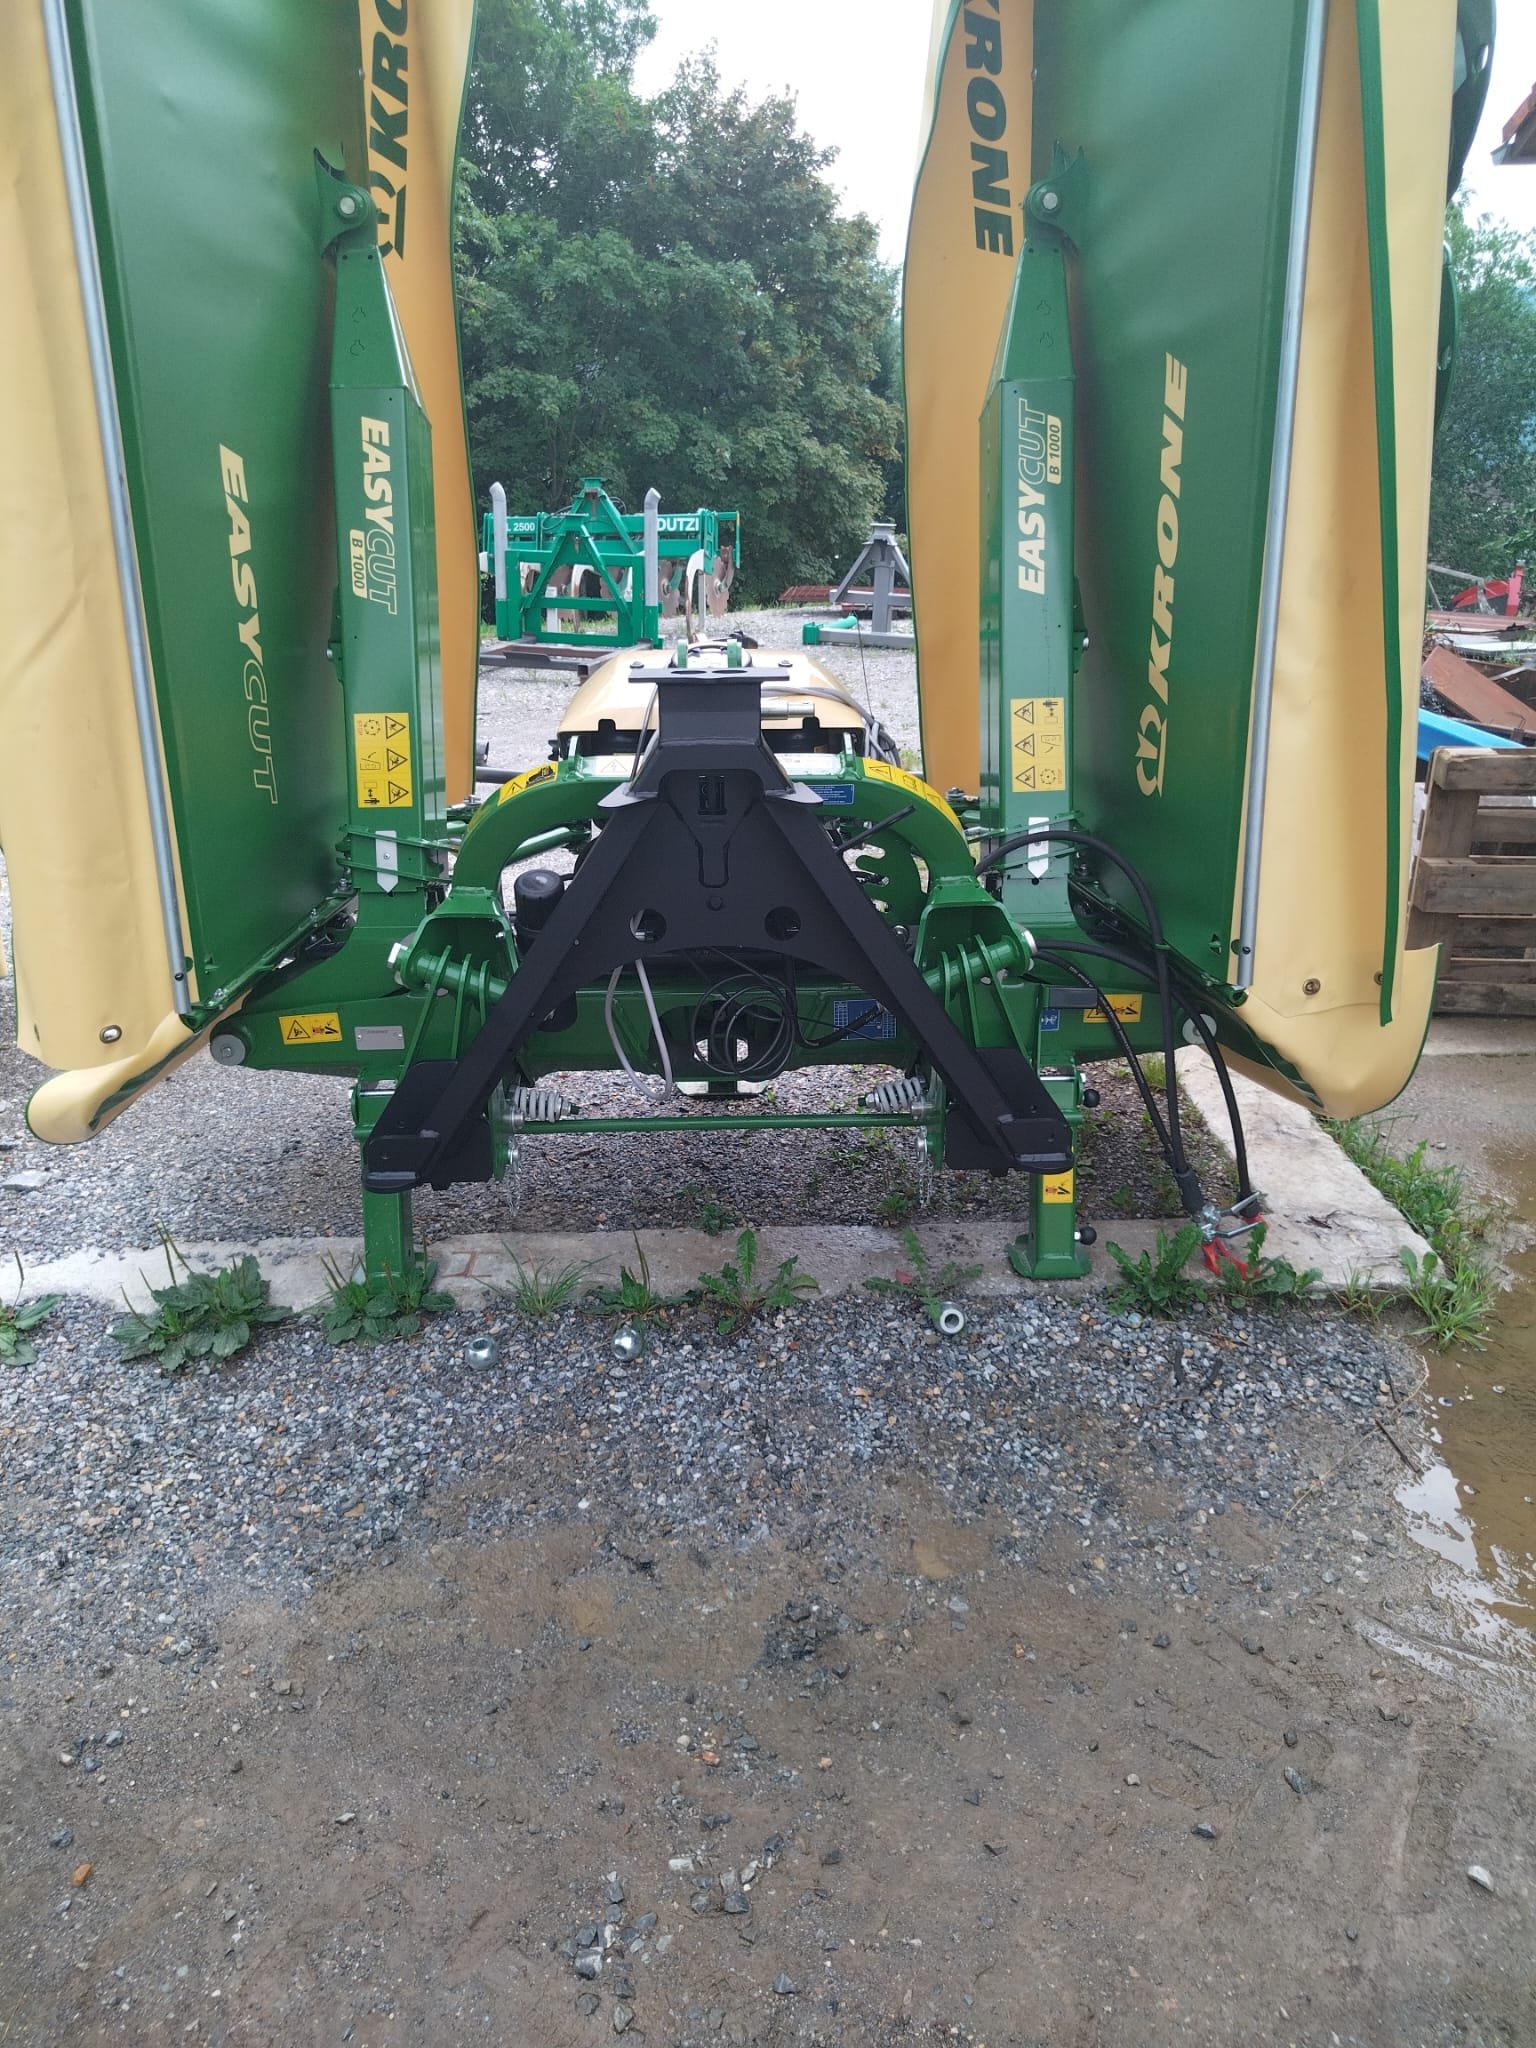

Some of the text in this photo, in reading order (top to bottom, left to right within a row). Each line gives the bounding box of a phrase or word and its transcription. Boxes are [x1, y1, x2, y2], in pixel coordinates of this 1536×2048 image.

[963, 0, 1014, 257] RONE
[361, 416, 398, 615] EASYCUT
[513, 522, 536, 532] 2500
[657, 517, 700, 532] DUTZI
[1018, 397, 1046, 595] EASYCUT
[1049, 424, 1061, 476] B 1000
[1148, 351, 1188, 706] KRONE
[219, 443, 278, 805] EASYCUT
[352, 537, 365, 590] B 1000
